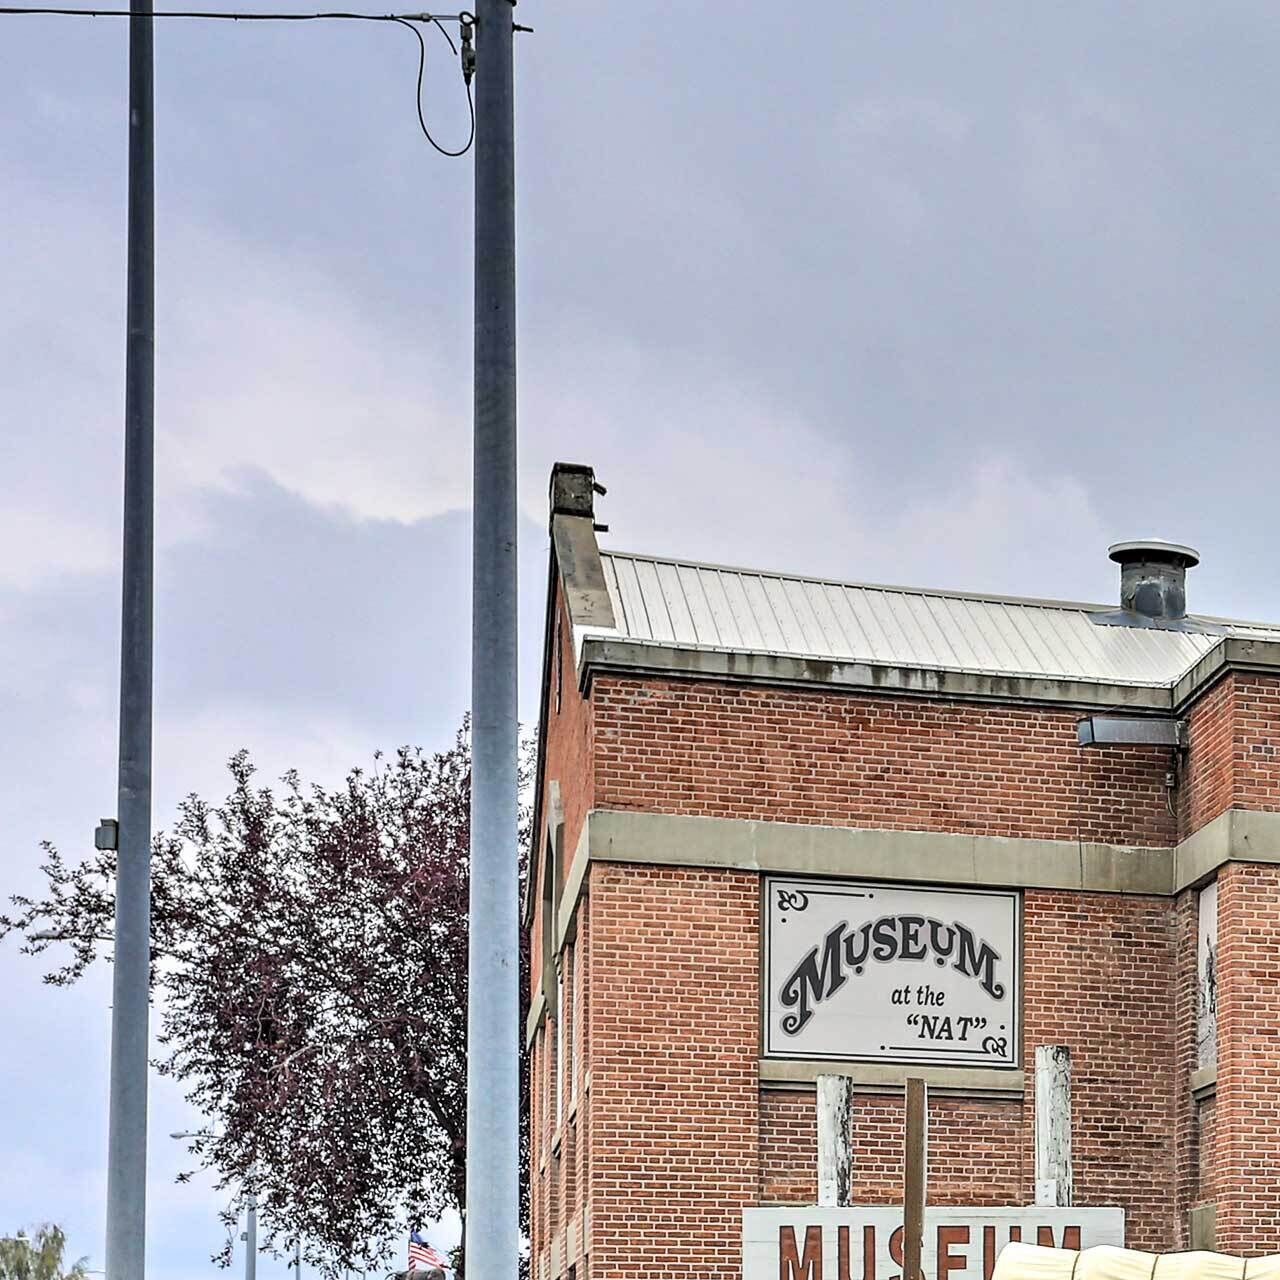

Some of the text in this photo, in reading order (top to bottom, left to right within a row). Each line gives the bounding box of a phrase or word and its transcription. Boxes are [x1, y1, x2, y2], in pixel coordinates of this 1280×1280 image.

[781, 916, 1004, 1034] MUSEUM
[891, 985, 945, 1006] at the
